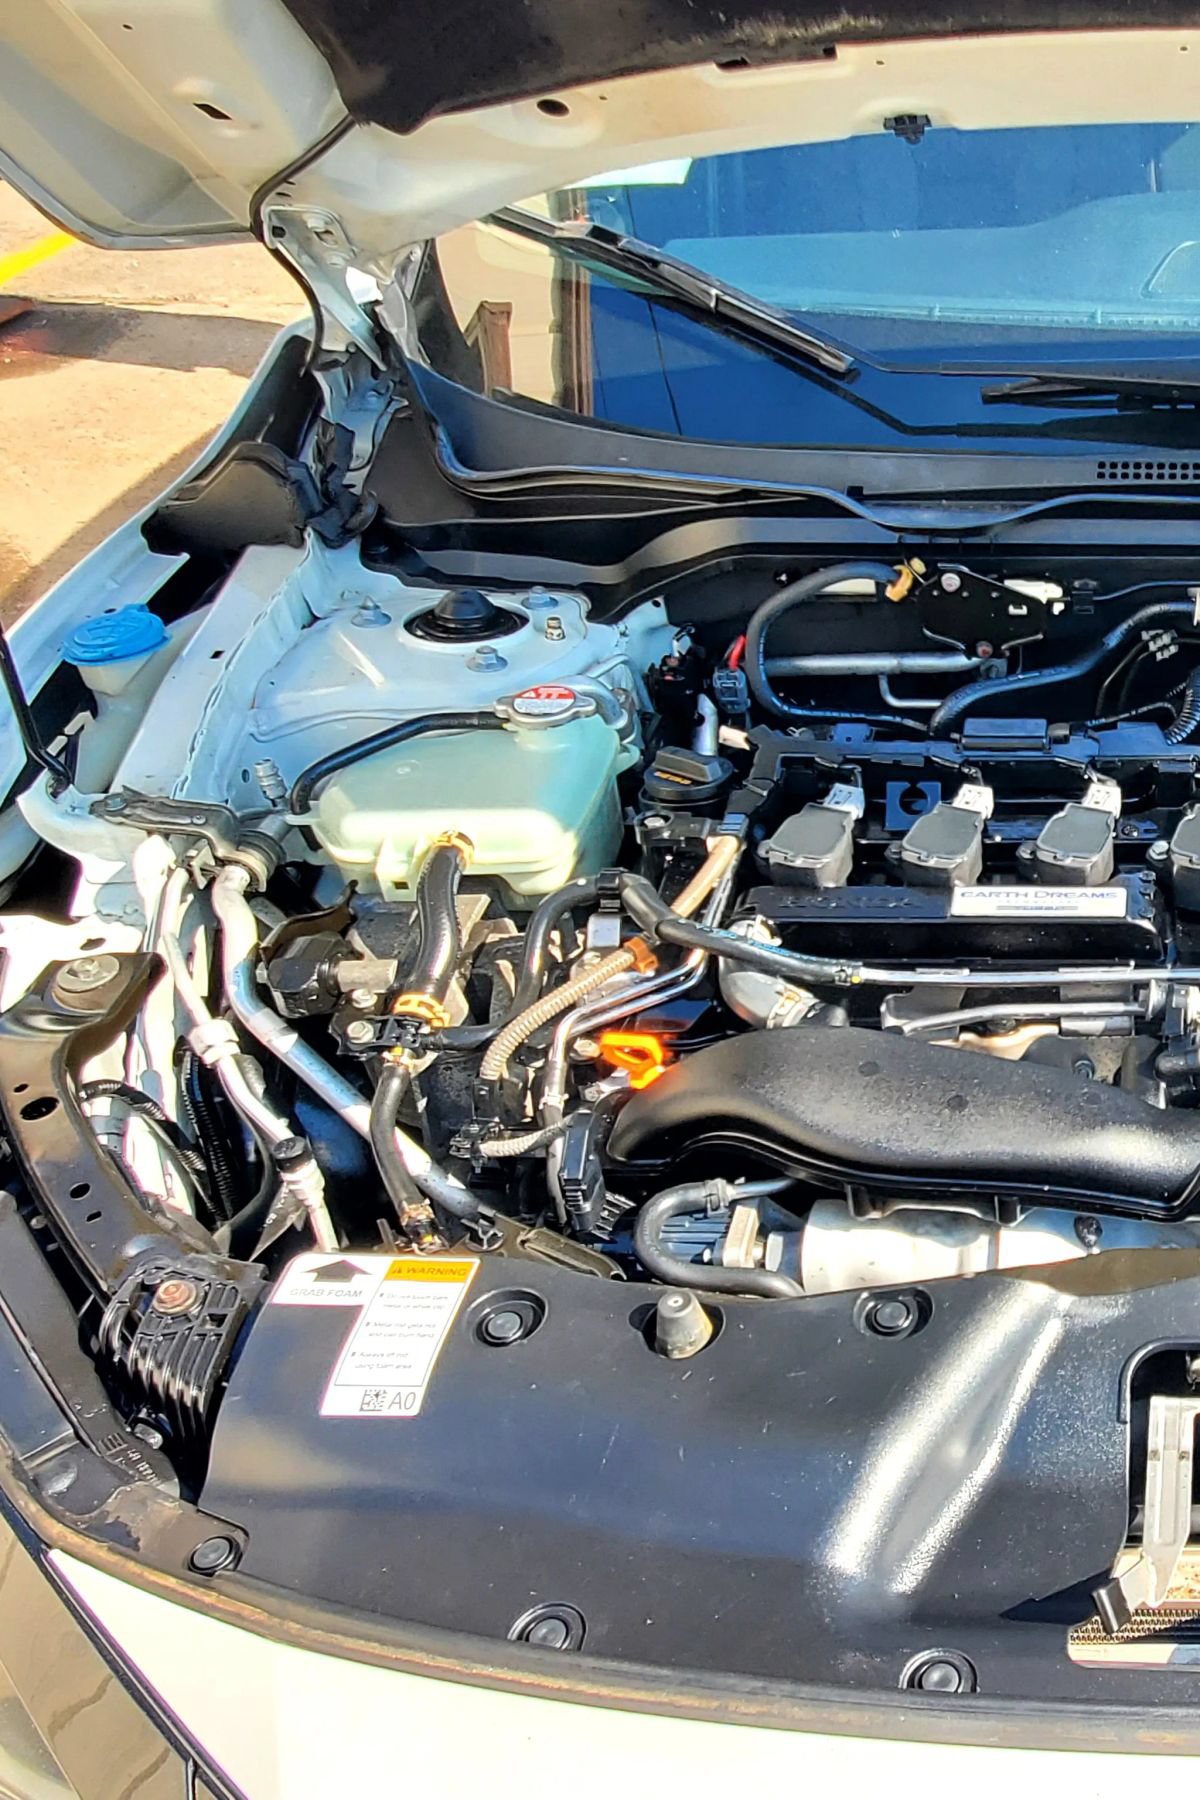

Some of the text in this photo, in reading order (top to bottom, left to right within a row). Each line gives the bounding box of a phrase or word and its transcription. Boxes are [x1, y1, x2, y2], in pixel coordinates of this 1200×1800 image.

[407, 1266, 467, 1276] WARNING
[289, 1288, 363, 1298] GRAB FOAM
[388, 1391, 416, 1410] A0
